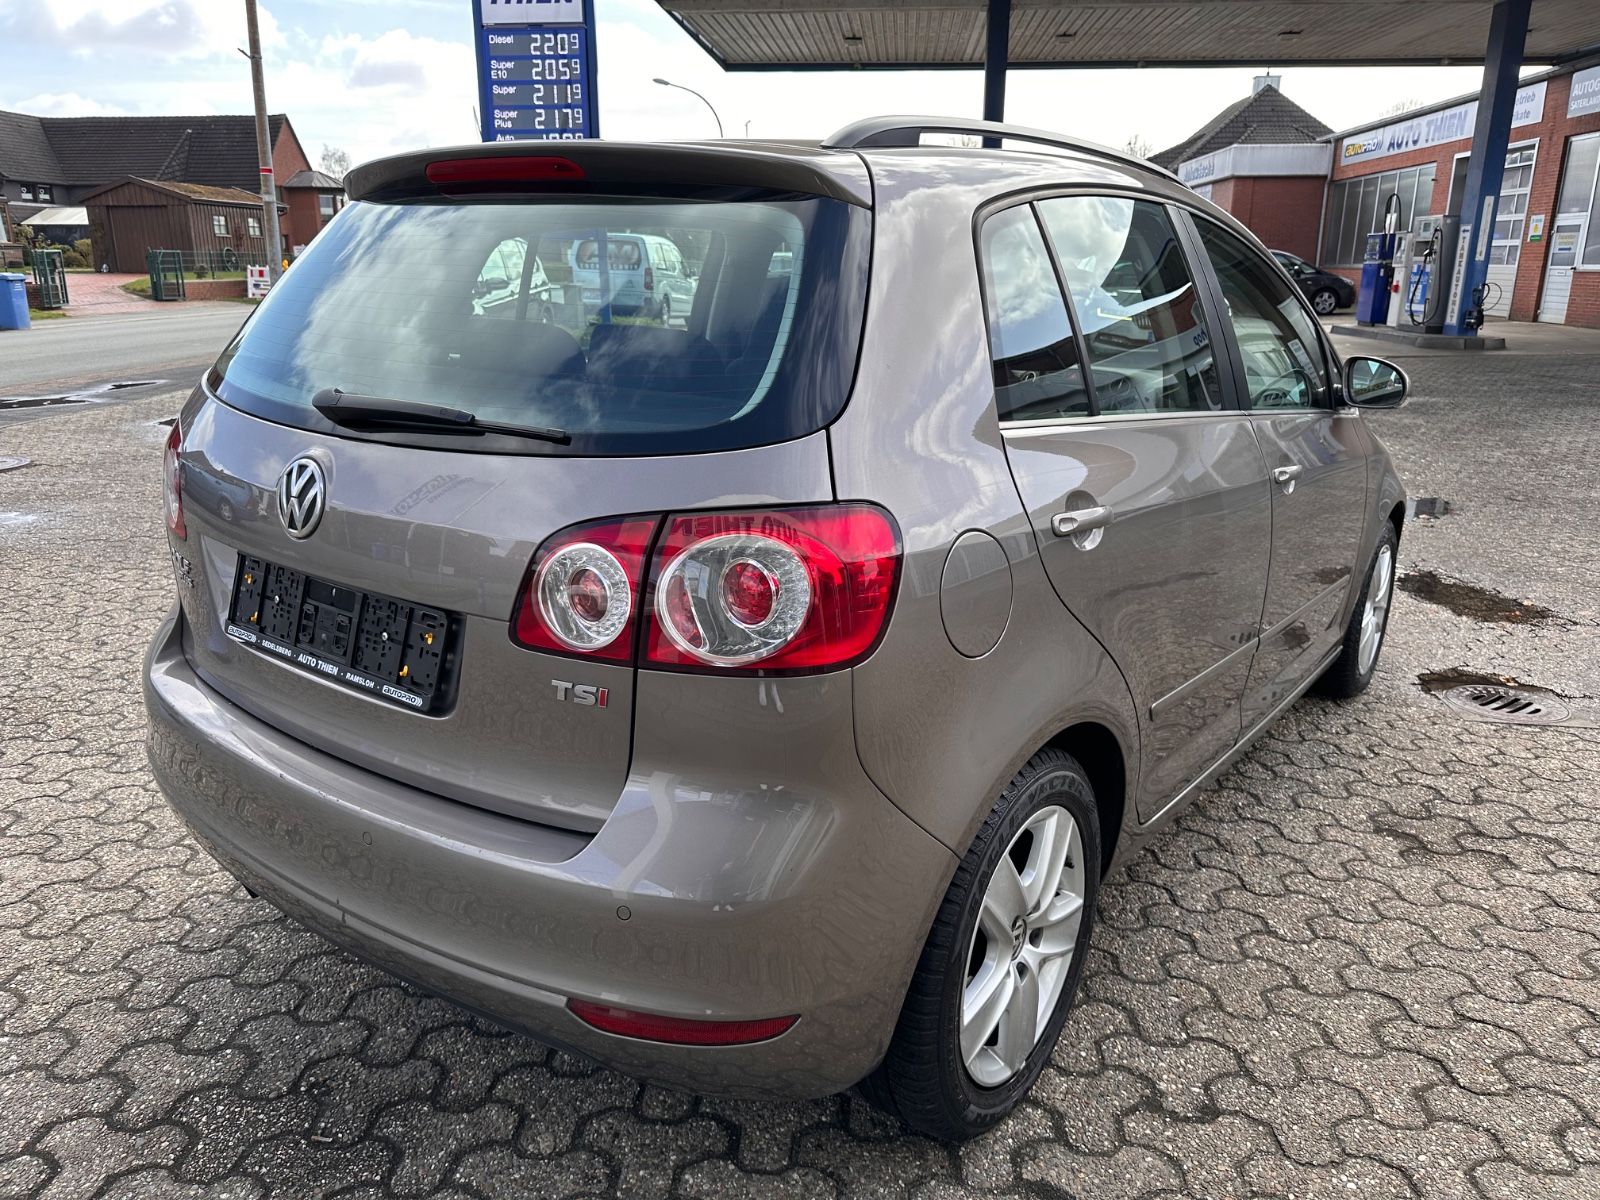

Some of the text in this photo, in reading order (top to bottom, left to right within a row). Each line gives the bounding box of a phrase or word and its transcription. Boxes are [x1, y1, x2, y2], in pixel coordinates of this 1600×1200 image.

[488, 34, 514, 44] Diesel
[490, 60, 515, 70] Super
[490, 70, 508, 79] E10
[492, 84, 517, 95] Super
[494, 109, 518, 120] Super
[494, 120, 513, 128] Plus
[1387, 124, 1421, 152] AUTO
[1424, 109, 1468, 144] THIEN
[261, 640, 292, 657] SEDELSBERG
[298, 653, 317, 667] AUTO
[318, 660, 339, 676] THIEN
[345, 672, 375, 688] RAMSLOH
[551, 679, 609, 708] TSI
